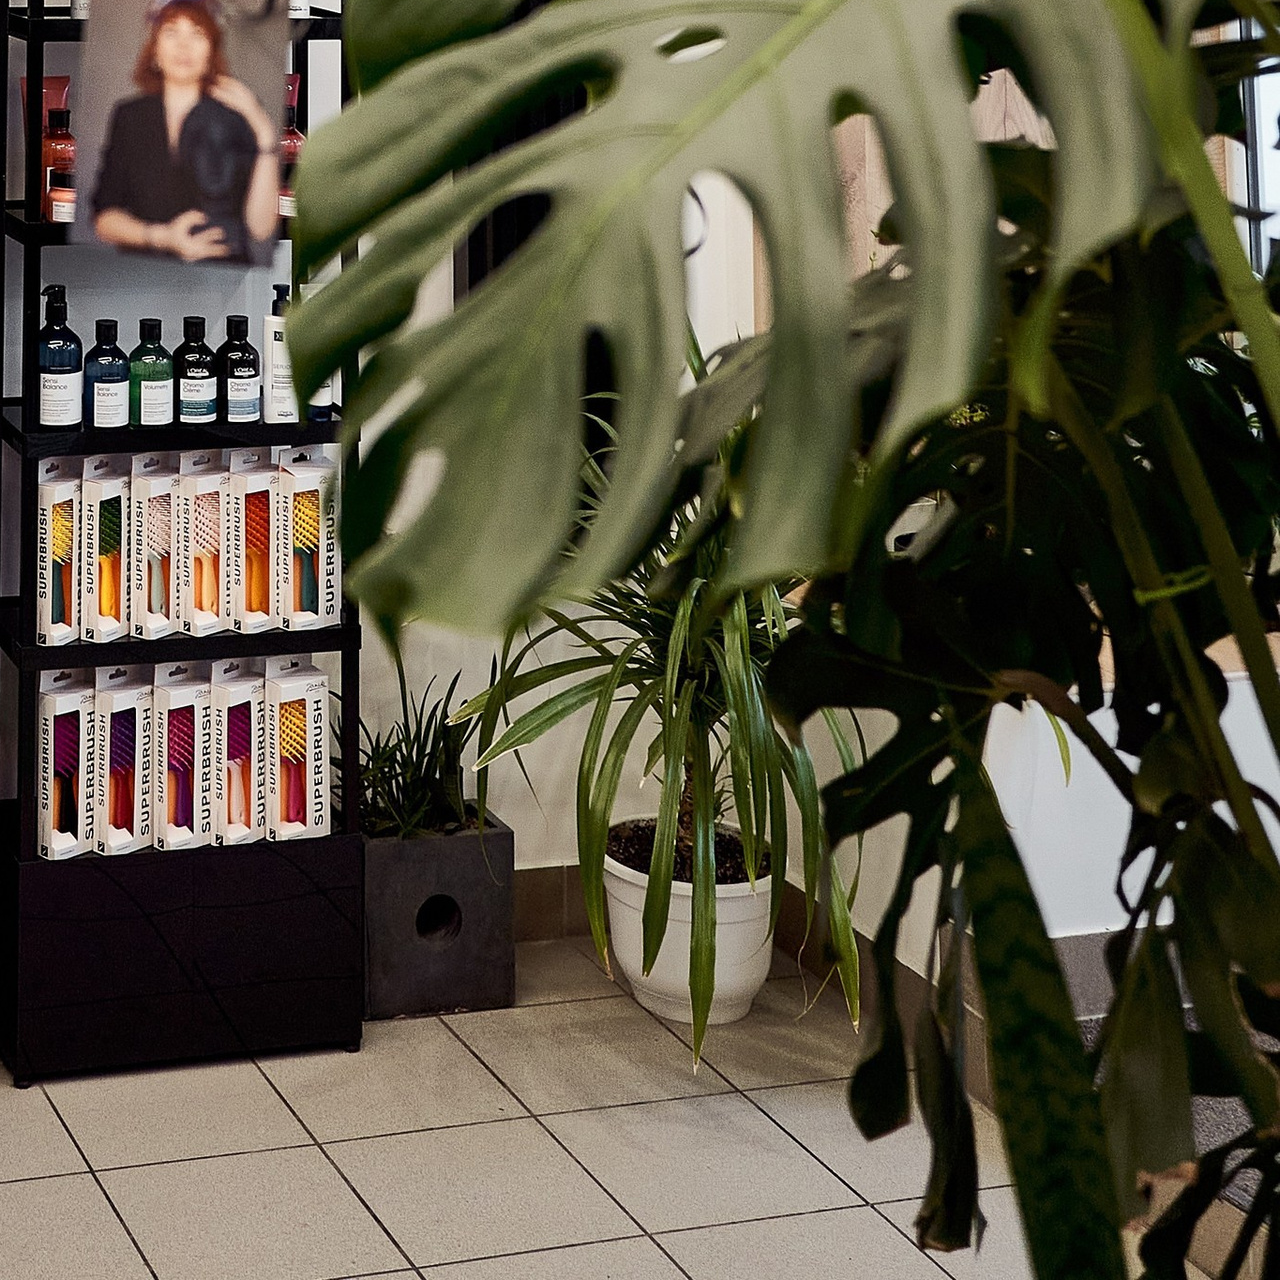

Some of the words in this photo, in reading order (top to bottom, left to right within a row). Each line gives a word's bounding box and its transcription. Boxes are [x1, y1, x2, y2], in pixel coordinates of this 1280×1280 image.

[42, 376, 58, 384] Sensi
[38, 508, 48, 600] SUPERBRUSH
[86, 503, 95, 595] SUPERBRUSH
[135, 500, 144, 591] SUPERBRUSH
[183, 497, 191, 588] SUPERBRUSH
[234, 496, 242, 587] SUPERBRUSH
[282, 495, 290, 585] SUPERBRUSH
[41, 717, 50, 811] SUPERBRUSH
[85, 710, 95, 840] SUPERBRUSH
[98, 714, 106, 807] SUPERBRUSH
[140, 707, 151, 836] SUPERBRUSH
[201, 705, 211, 834] SUPERBRUSH
[215, 708, 223, 800] SUPERBRUSH
[257, 700, 265, 828] SUPERBRUSH
[314, 698, 324, 826] SUPERBRUSH
